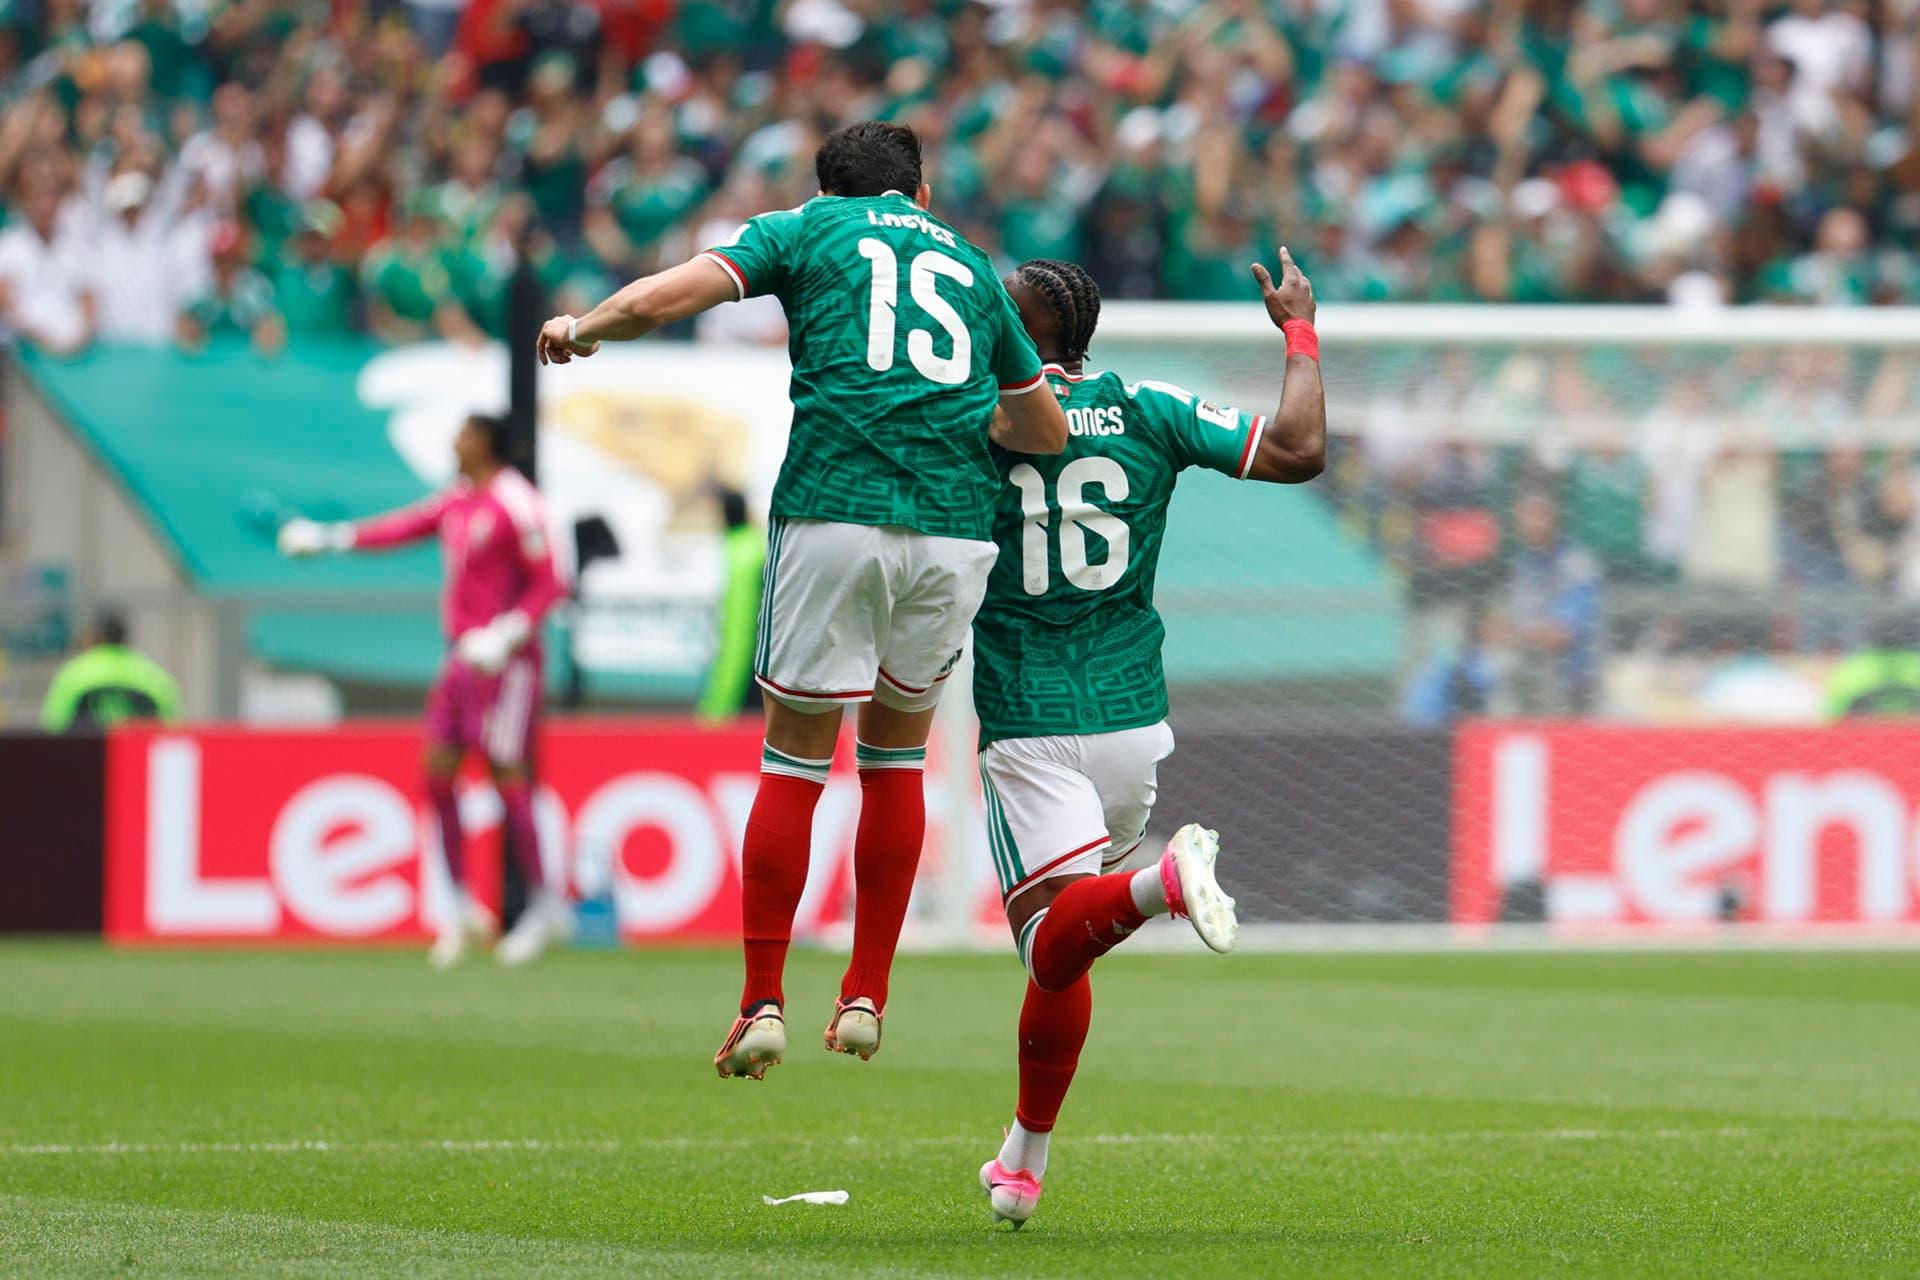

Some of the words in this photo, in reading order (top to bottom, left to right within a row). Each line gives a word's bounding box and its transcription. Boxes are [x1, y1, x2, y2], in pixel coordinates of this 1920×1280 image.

[858, 237, 974, 384] 15
[1065, 406, 1125, 436] ONES
[1009, 456, 1130, 596] 16
[1491, 733, 1920, 920] Len
